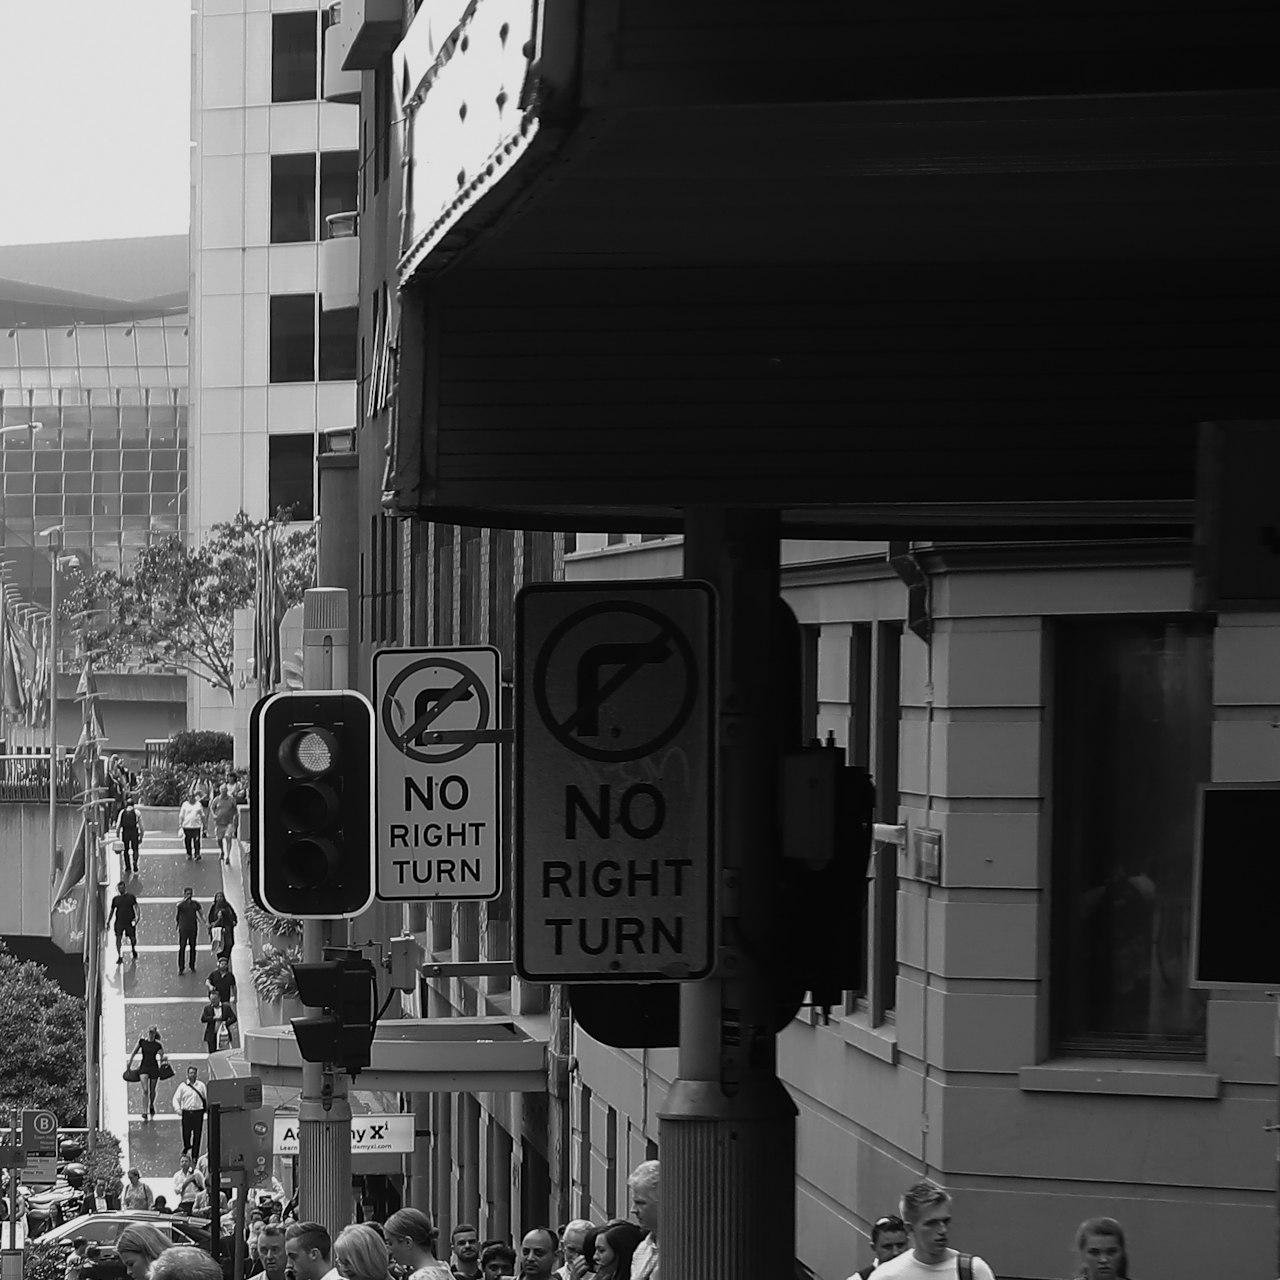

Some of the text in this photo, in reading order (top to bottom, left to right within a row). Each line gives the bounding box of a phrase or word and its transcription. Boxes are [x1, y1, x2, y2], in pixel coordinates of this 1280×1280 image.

[403, 775, 470, 812] NO
[564, 783, 666, 840] NO
[390, 823, 486, 848] RIGHT
[392, 858, 481, 884] TURN
[542, 859, 693, 898] RIGHT
[544, 918, 683, 956] TURN
[40, 1118, 49, 1129] B
